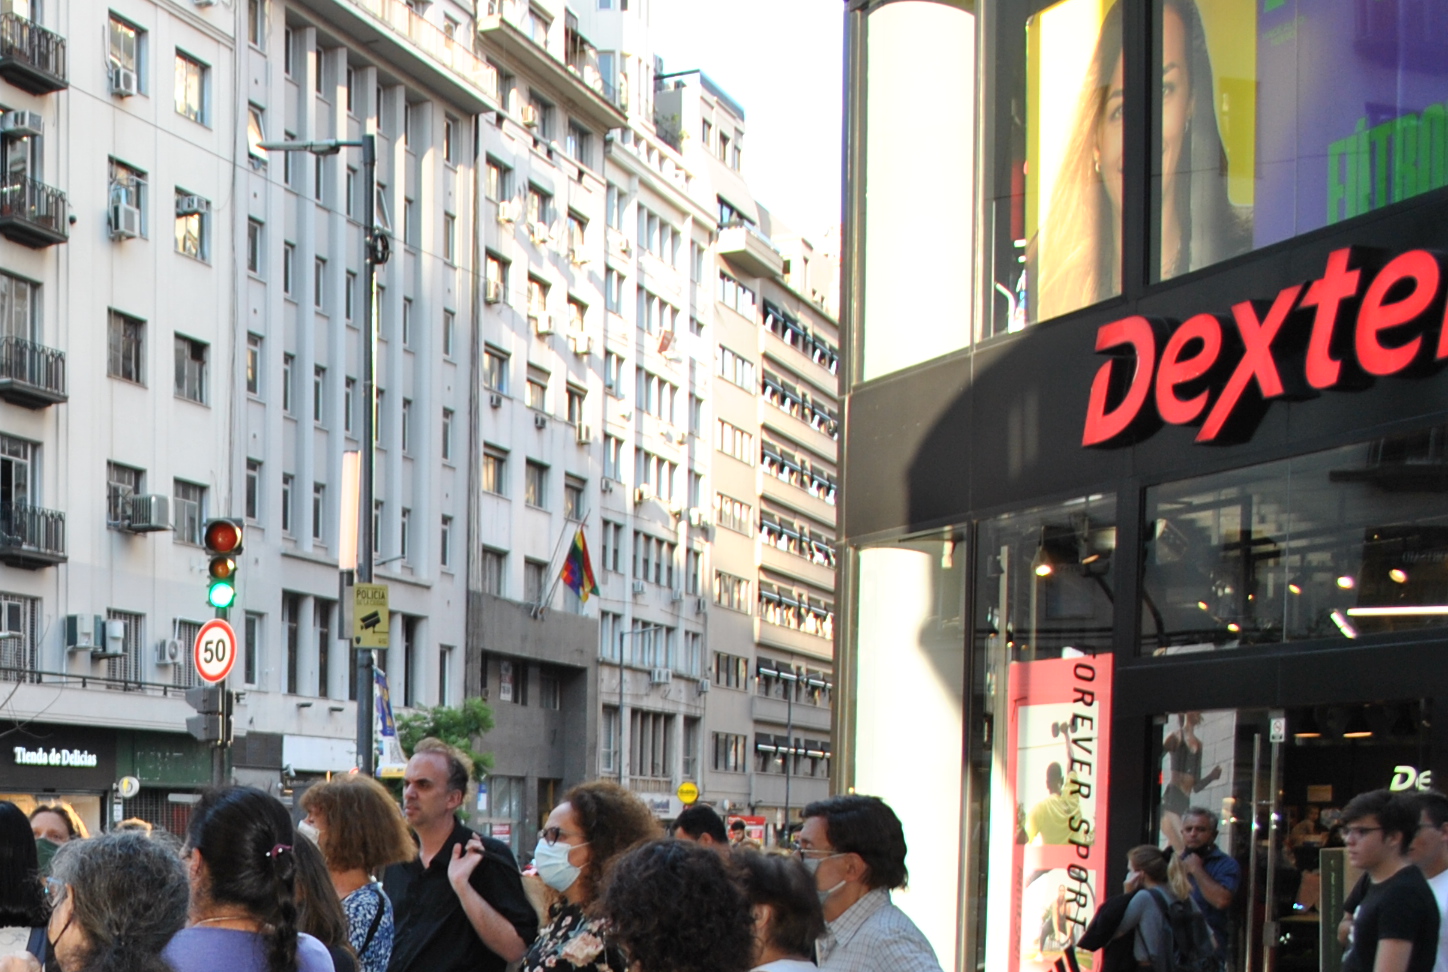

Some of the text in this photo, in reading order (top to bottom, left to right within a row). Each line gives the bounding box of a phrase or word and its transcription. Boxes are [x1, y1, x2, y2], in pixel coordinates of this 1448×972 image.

[1082, 247, 1448, 447] Dexte
[203, 638, 226, 664] 50
[14, 747, 97, 767] Tienda de Delicias
[1065, 814, 1091, 932] SPORT
